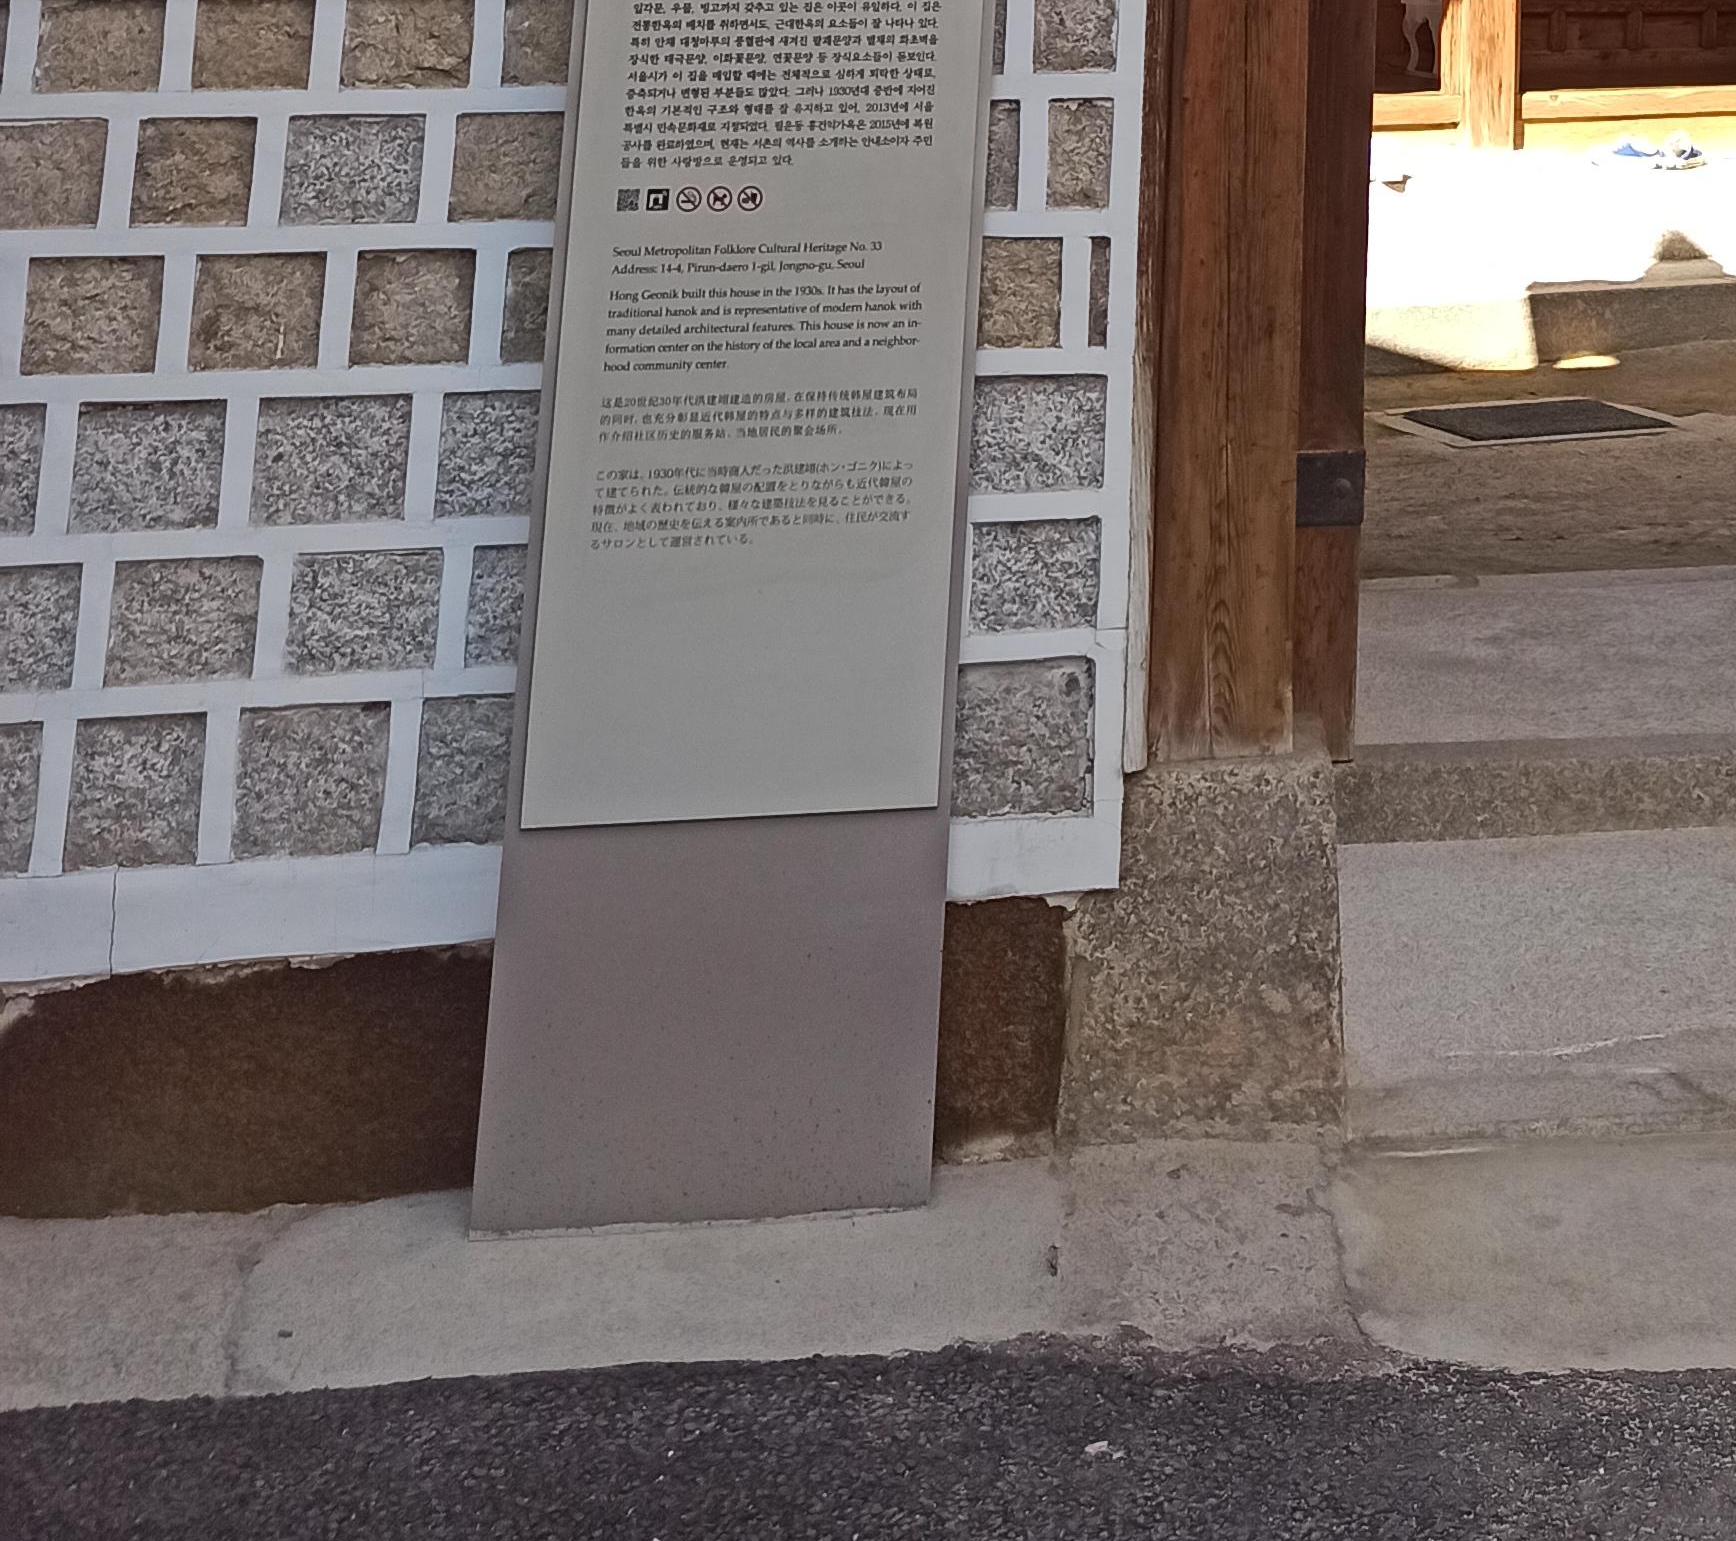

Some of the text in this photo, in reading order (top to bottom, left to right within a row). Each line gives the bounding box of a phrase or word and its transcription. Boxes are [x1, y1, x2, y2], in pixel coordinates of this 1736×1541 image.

[612, 246, 643, 257] Seoul
[643, 245, 712, 258] Metropolitan
[713, 243, 757, 255] Folklore
[757, 243, 802, 253] Cultural
[802, 242, 848, 254] Heritage
[871, 240, 883, 251] 33
[686, 261, 750, 273] Pirun-daero
[836, 258, 865, 269] Seoul
[608, 290, 640, 303] Hong
[640, 288, 679, 300] Geonik
[680, 288, 707, 298] built
[707, 287, 728, 298] this
[729, 287, 761, 298] house
[775, 286, 792, 296] the
[827, 284, 836, 294] It
[836, 284, 856, 295] has
[856, 284, 874, 294] the
[875, 284, 909, 294] layout
[909, 282, 921, 293] of
[606, 299, 923, 318] traditional hanok and is representative of modern hanok with
[605, 328, 635, 336] many
[637, 324, 682, 335] detailed
[683, 323, 750, 333] architectural
[799, 319, 821, 330] This
[822, 320, 854, 330] house
[855, 320, 865, 329] is
[891, 320, 905, 328] an
[604, 344, 657, 354] formation
[657, 343, 689, 352] center
[690, 343, 705, 351] on
[706, 340, 723, 351] the
[724, 340, 761, 350] history
[762, 339, 774, 349] of
[774, 339, 792, 349] the
[793, 338, 818, 348] local
[818, 339, 841, 348] area
[842, 336, 863, 347] and
[871, 335, 921, 348] neighbor-
[602, 361, 632, 372] hood
[632, 361, 693, 371] community
